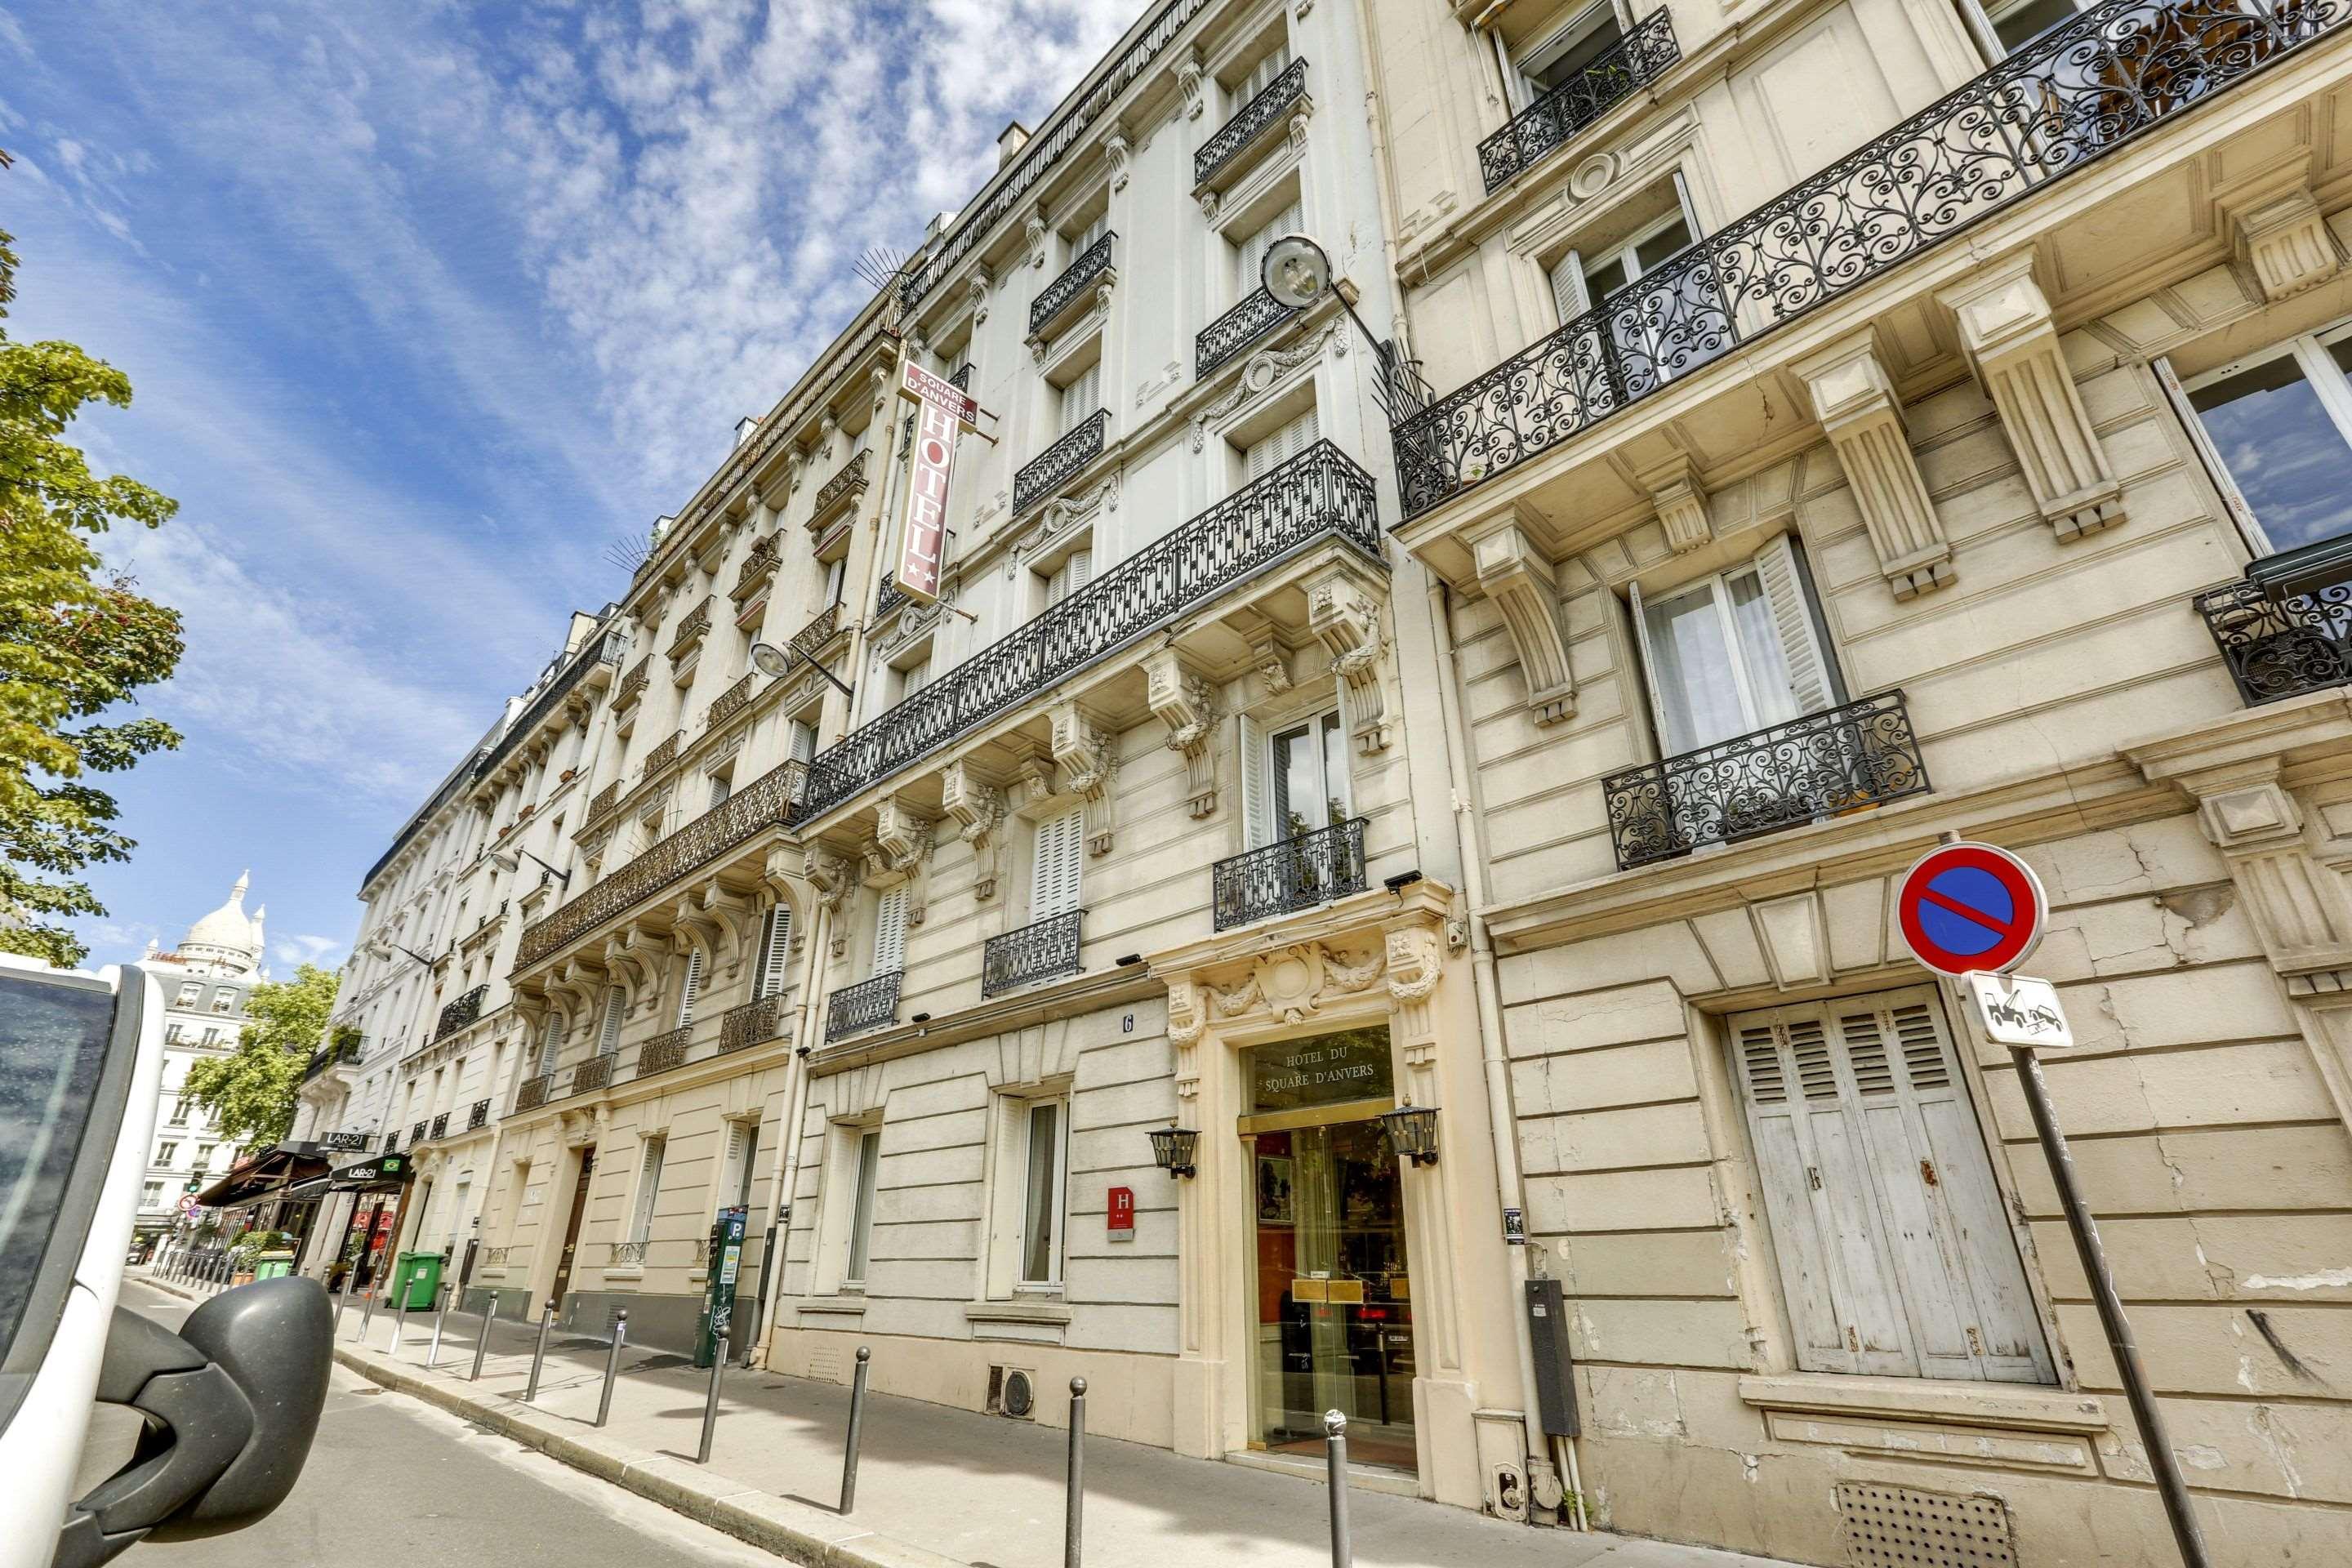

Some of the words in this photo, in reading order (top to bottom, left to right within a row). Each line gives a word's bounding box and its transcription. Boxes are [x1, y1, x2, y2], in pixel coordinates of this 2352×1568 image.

[908, 376, 975, 421] D'ANVERS
[919, 372, 966, 404] SQUARE
[909, 405, 954, 564] HOTEL
[1125, 1015, 1133, 1032] 6
[1287, 1051, 1324, 1067] HOTEL
[1330, 1046, 1348, 1060] DU
[1266, 1074, 1309, 1093] SQUARE
[1316, 1064, 1374, 1084] D'ANVERS
[1117, 1194, 1129, 1209] H
[733, 1223, 742, 1236] P
